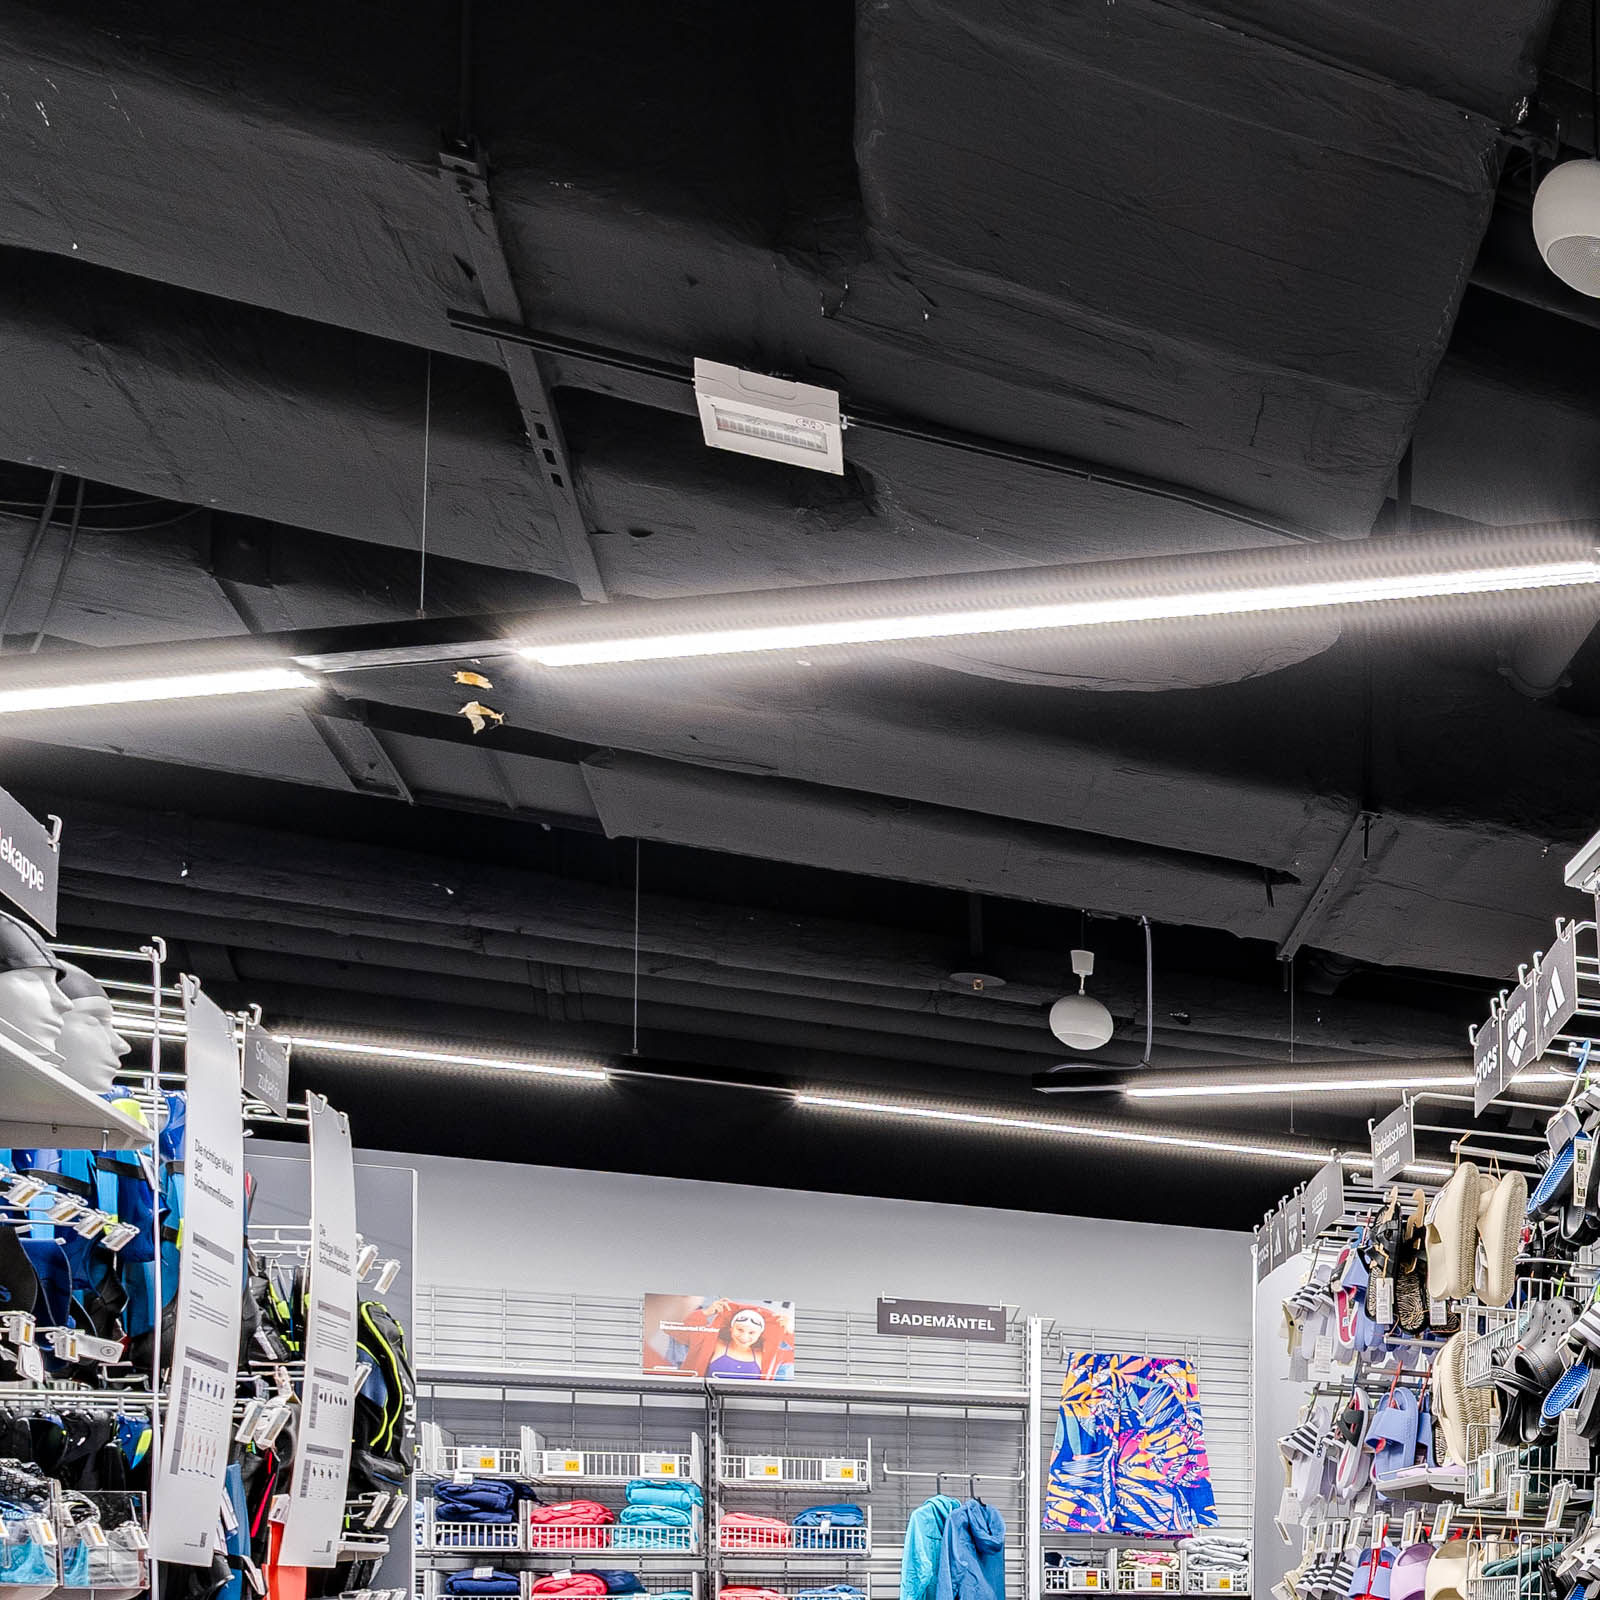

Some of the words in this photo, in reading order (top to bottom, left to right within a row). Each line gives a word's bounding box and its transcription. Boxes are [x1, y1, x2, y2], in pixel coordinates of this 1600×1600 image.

[0, 835, 45, 891] ekappe
[1507, 1000, 1527, 1041] arena
[1476, 1045, 1498, 1088] crocs
[889, 1313, 995, 1331] BADEMÄNTEL
